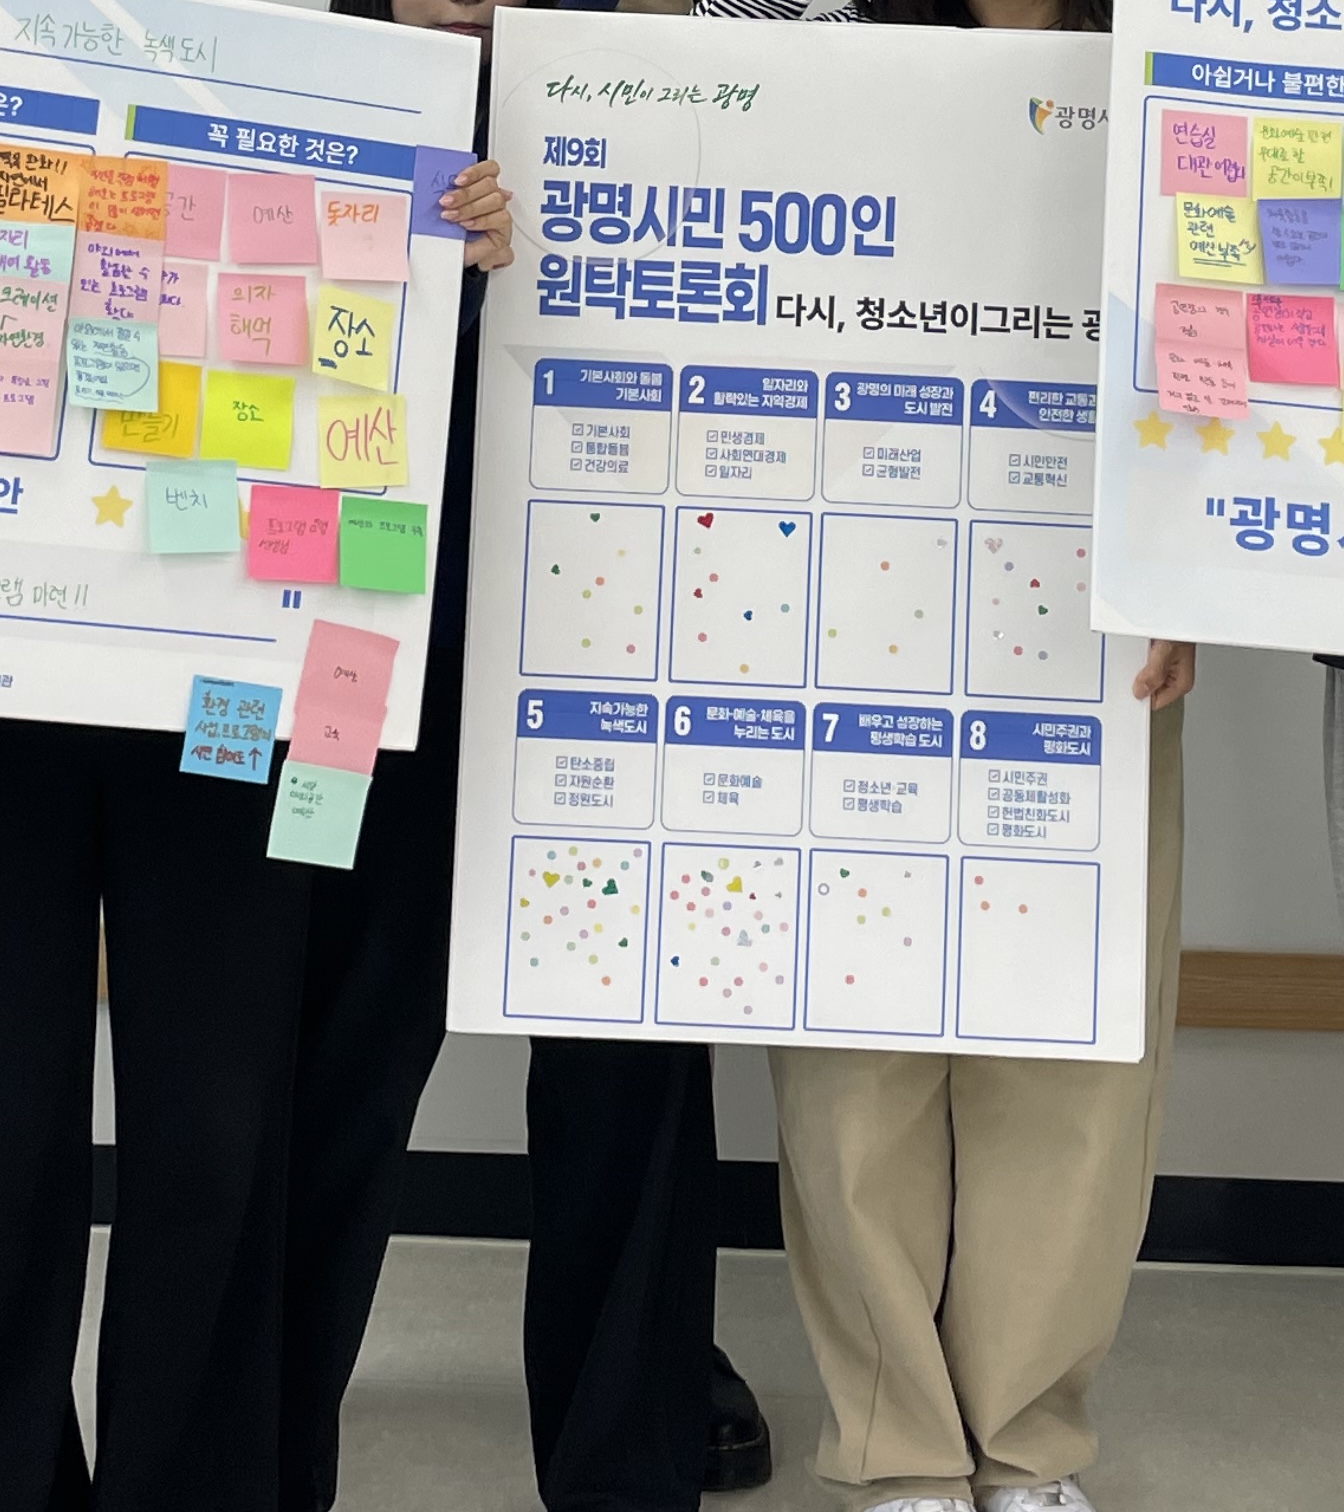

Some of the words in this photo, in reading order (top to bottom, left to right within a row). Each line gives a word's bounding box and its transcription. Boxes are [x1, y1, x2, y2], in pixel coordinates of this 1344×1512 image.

[1191, 62, 1277, 94] 아쉽거나
[545, 74, 593, 104] 다시,
[597, 78, 655, 108] 시민이
[656, 84, 708, 106] 그리는
[712, 83, 760, 112] 광명
[207, 124, 228, 149] 꼭
[235, 126, 300, 162] 필요한
[304, 132, 360, 168] 것은?
[542, 135, 608, 170] 제9회
[252, 203, 294, 225] 예산
[327, 200, 380, 226] 돗자리
[540, 180, 726, 249] 광명시민
[737, 190, 898, 258] 500인
[536, 254, 769, 326] 원탁토론회
[775, 293, 846, 334] 다시,
[855, 296, 1074, 341] 청소년이그리는
[327, 304, 376, 358] 장소
[542, 369, 555, 396] 1
[579, 369, 638, 385] 기본사회와
[687, 374, 706, 405] 2
[762, 376, 809, 392] 일자리와
[615, 387, 662, 403] 기본사회
[762, 394, 809, 410] 지역경제
[834, 382, 852, 412] 3
[893, 385, 918, 399] 미래
[979, 390, 998, 419] 4
[903, 402, 928, 416] 도시
[326, 406, 399, 466] 예산
[586, 424, 631, 440] 기본사회
[720, 430, 765, 447] 민생경제
[584, 458, 629, 474] 건강의료
[877, 446, 922, 463] 미래산업
[718, 464, 753, 481] 일자리
[526, 699, 544, 729] 5
[589, 700, 649, 717] 지속가능한
[673, 705, 692, 737] 6
[599, 719, 648, 735] 녹색도시
[733, 724, 770, 740] 누리는
[771, 726, 796, 741] 도시
[821, 713, 840, 743] 7
[968, 719, 987, 751] 8
[918, 733, 943, 749] 도시
[717, 773, 763, 789] 문화예술
